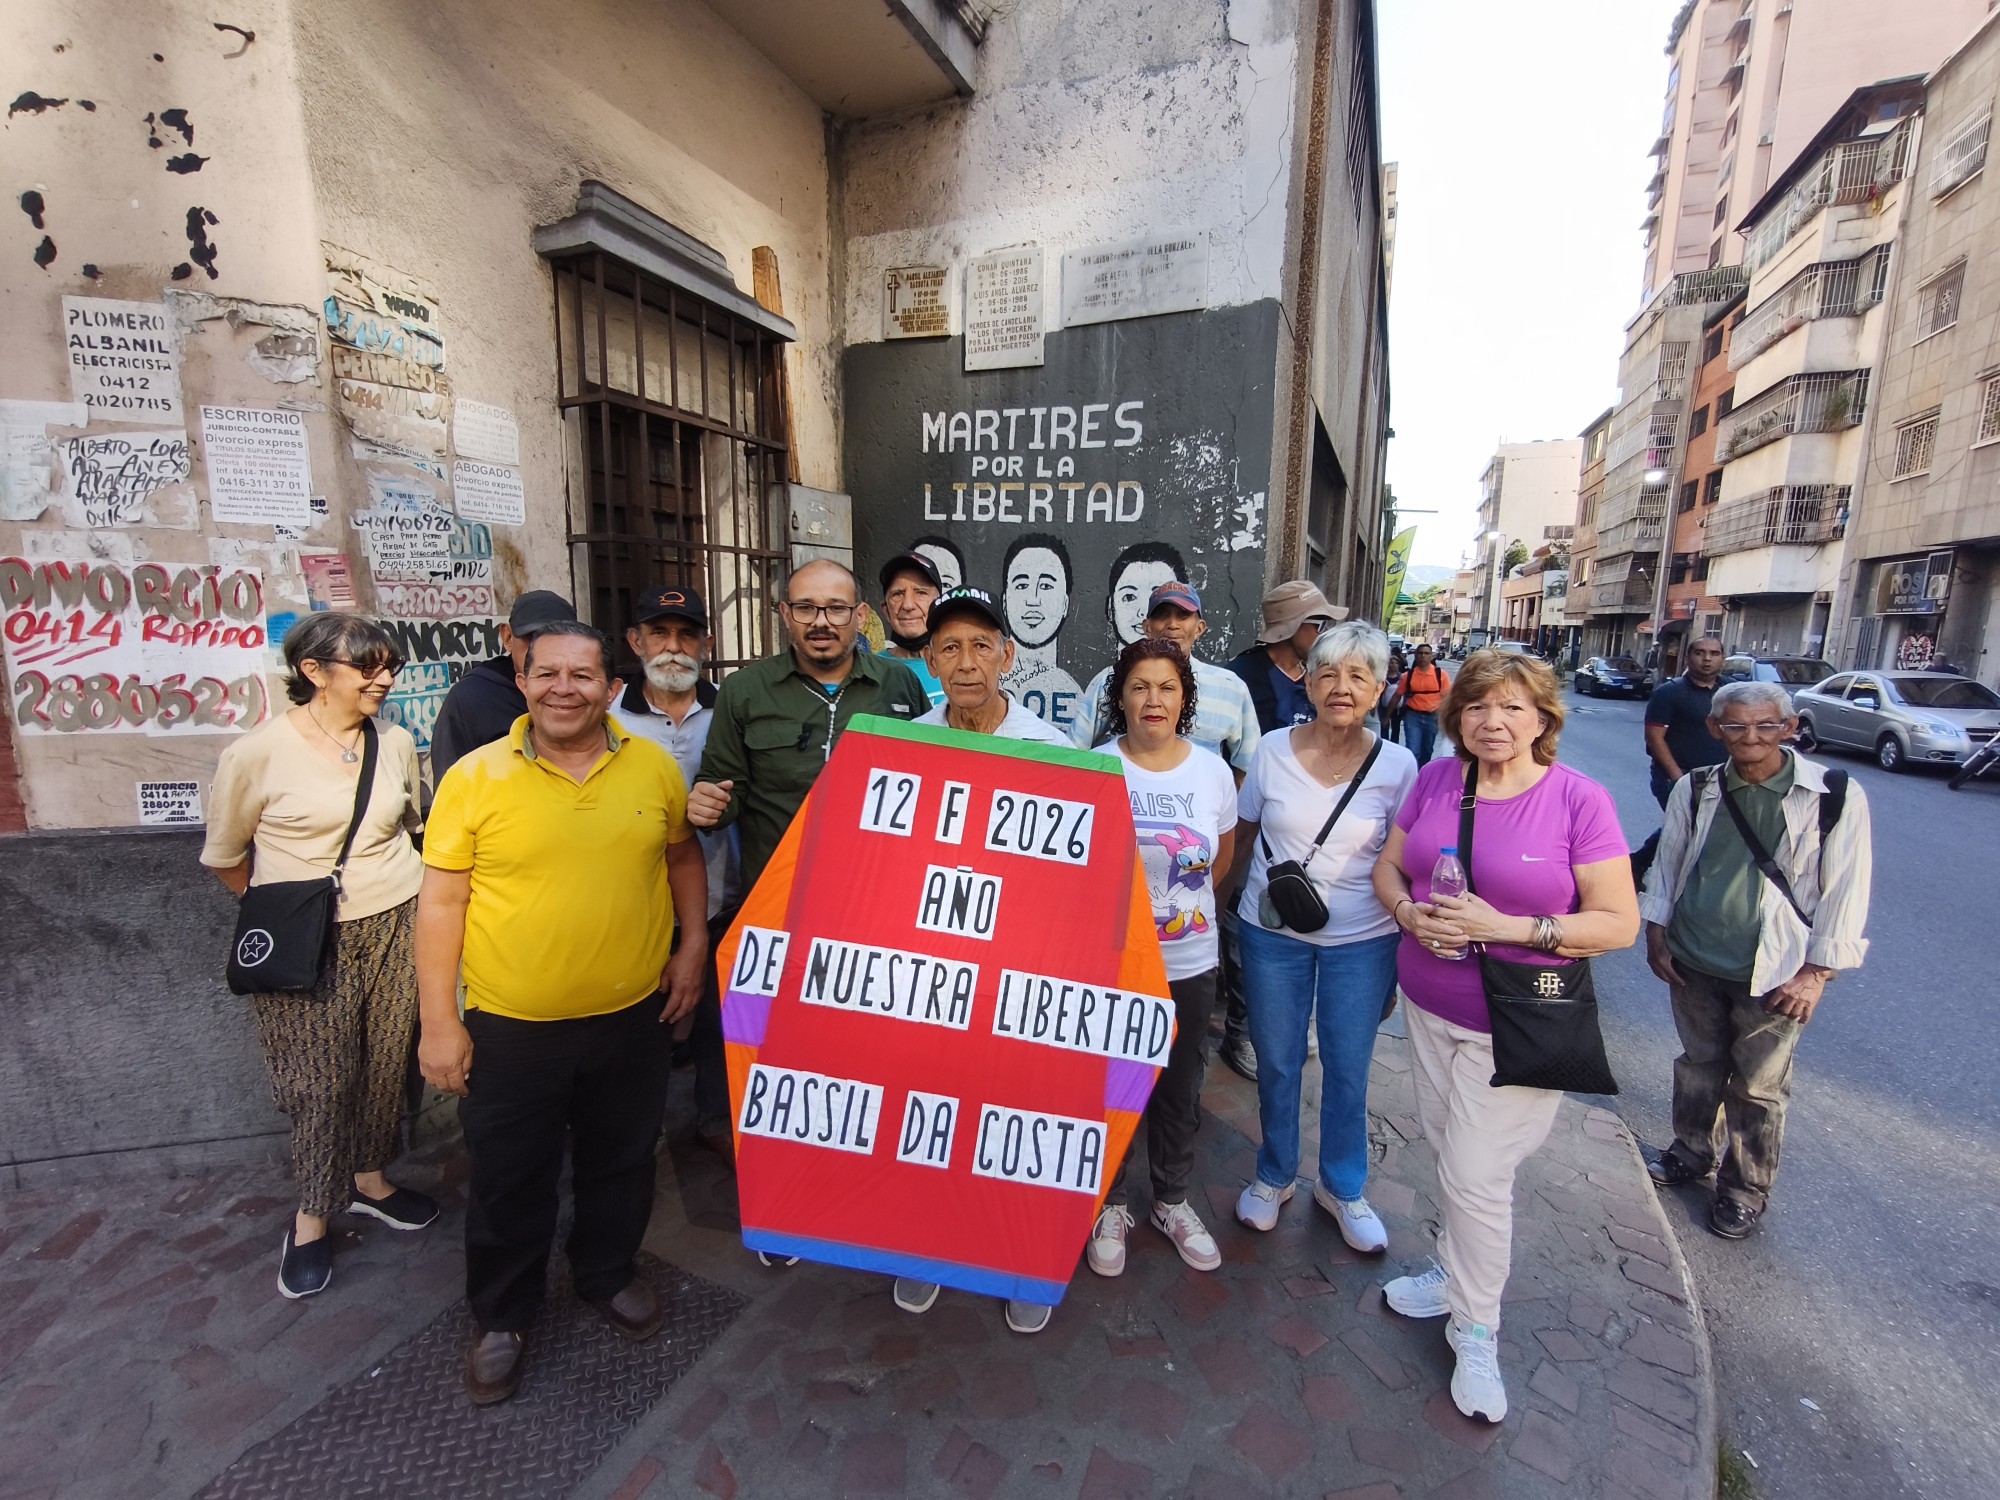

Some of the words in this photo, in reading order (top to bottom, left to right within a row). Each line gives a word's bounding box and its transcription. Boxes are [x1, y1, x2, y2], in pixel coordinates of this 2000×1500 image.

[977, 262, 998, 273] CONAN
[973, 290, 989, 300] LUIS
[1011, 283, 1039, 295] ALVAREZ
[69, 309, 165, 331] PLOMERO
[992, 319, 999, 327] DE
[1006, 324, 1033, 334] MUEREN
[968, 338, 981, 347] POR
[983, 337, 991, 345] LA
[72, 353, 172, 371] ELECTRICISTA
[100, 375, 150, 390] 0412
[203, 408, 301, 426] ESCRITORIO
[922, 401, 1144, 453] MARTIRES
[205, 433, 255, 446] Divorcio
[258, 437, 304, 449] express
[455, 461, 512, 479] ABOGADO
[971, 455, 1024, 477] POR
[1036, 455, 1075, 478] LA
[272, 480, 285, 489] 37
[288, 481, 301, 490] 01
[454, 473, 490, 487] Divorcio
[491, 481, 522, 492] express
[924, 480, 1145, 524] LIBERTAD
[0, 556, 265, 622] DIVORCIO
[4, 609, 123, 647] 0414
[14, 669, 268, 733] 2880529
[141, 782, 198, 791] DIVORCIO
[141, 790, 169, 799] 0414
[871, 775, 914, 830] 12
[942, 786, 965, 837] F
[990, 795, 1090, 859] 2026
[921, 867, 997, 934] AÑO
[736, 929, 784, 991] DE
[805, 942, 974, 1025] NUESTRA
[998, 974, 1170, 1059] LIBERTAD
[743, 1069, 871, 1149] BASSIL
[902, 1095, 953, 1163] DA
[978, 1109, 1101, 1189] COSTA
